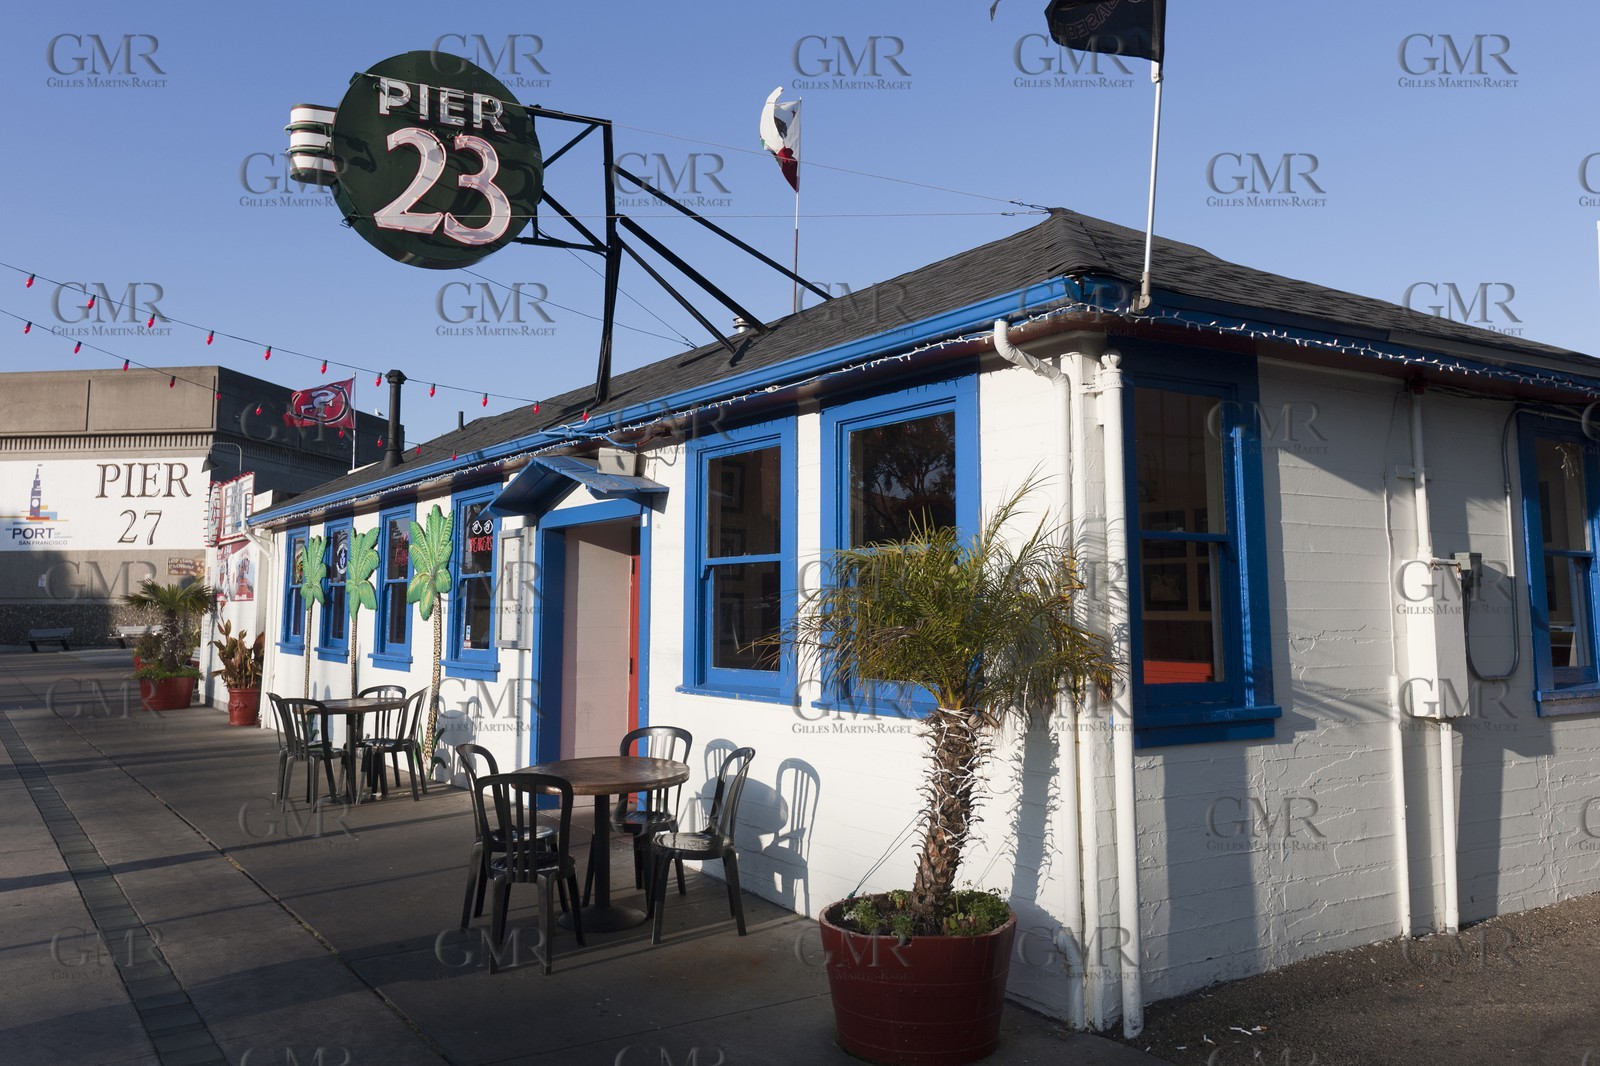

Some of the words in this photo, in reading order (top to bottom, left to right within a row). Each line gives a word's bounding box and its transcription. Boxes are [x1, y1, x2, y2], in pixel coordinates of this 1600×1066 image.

[378, 76, 507, 132] PIER
[373, 127, 511, 245] 23
[95, 462, 192, 498] PIER
[12, 528, 55, 539] PORT
[117, 509, 163, 545] 27
